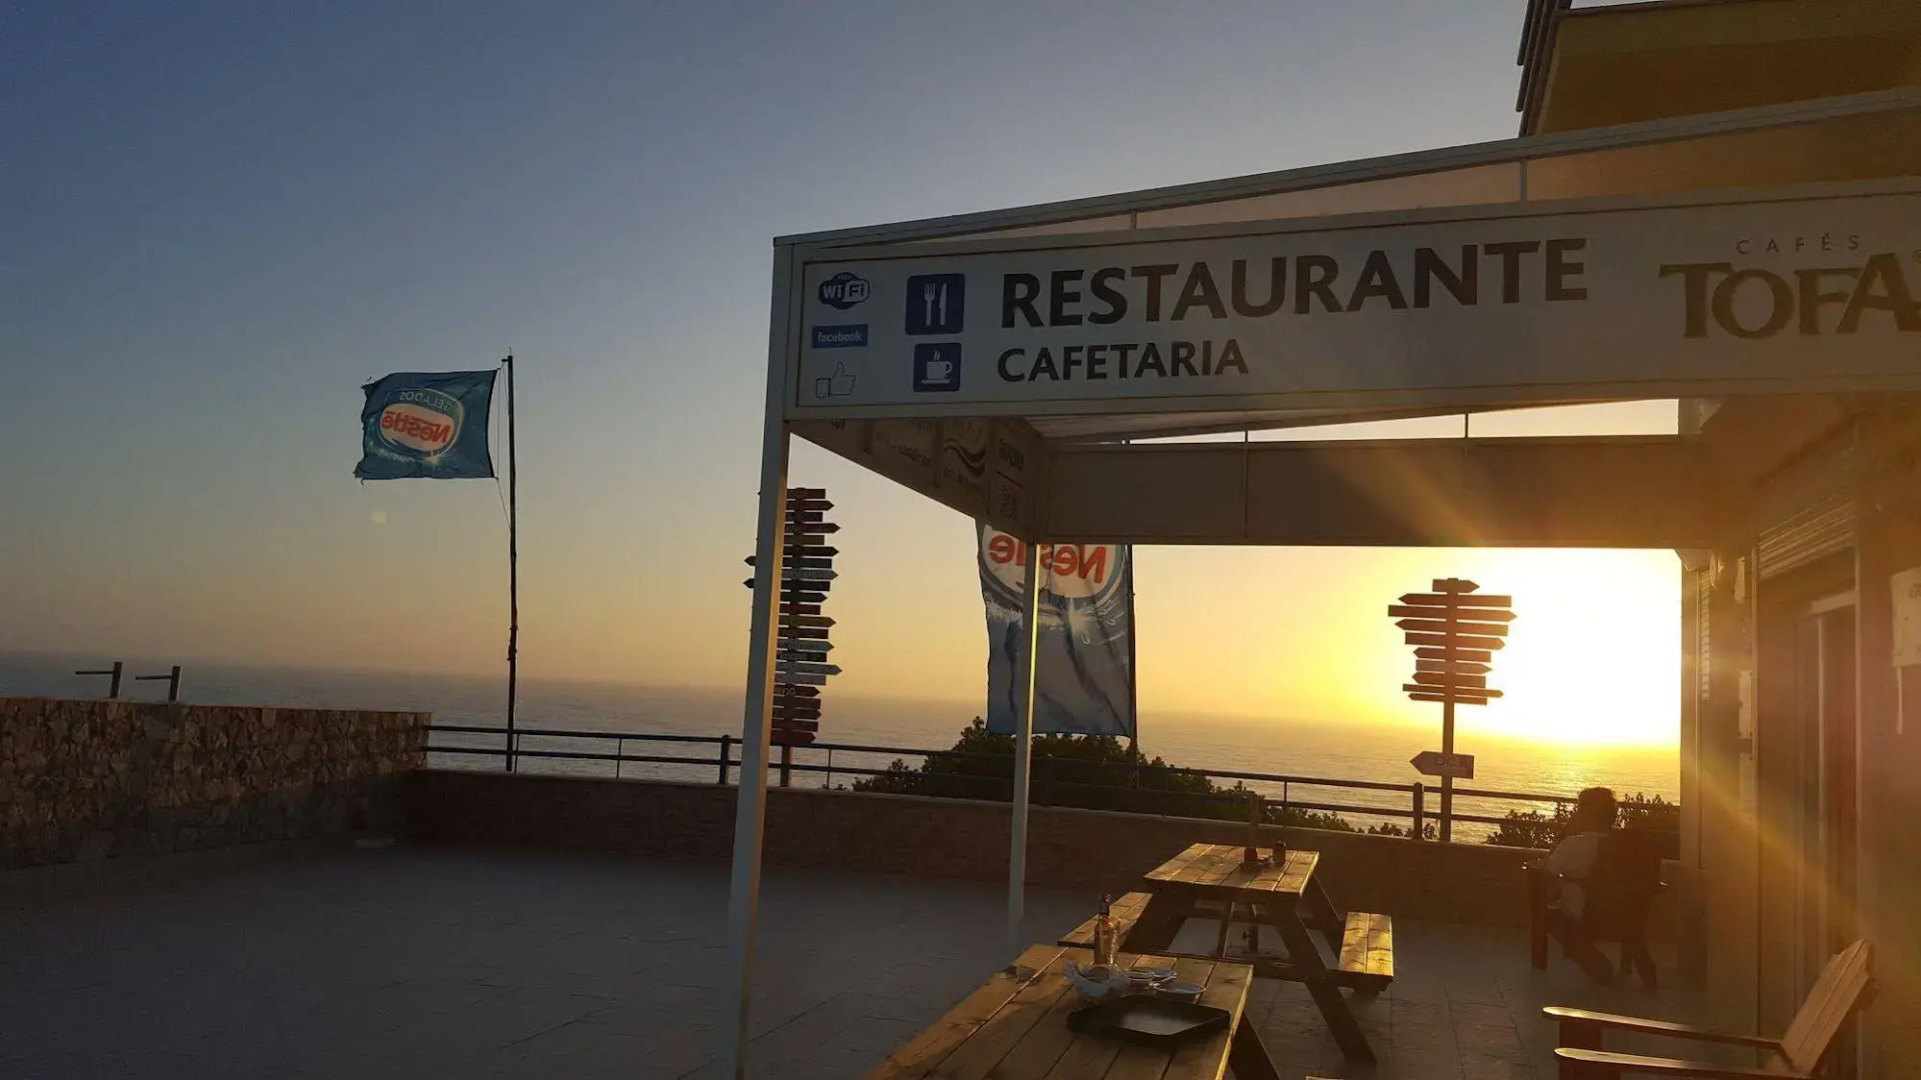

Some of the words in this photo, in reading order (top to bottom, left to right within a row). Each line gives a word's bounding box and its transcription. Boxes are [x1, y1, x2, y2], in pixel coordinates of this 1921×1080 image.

[1736, 231, 1860, 254] CAFÉS
[1002, 238, 1588, 328] RESTAURANTE
[1658, 253, 1921, 339] TOFA
[817, 330, 863, 343] facebook
[997, 338, 1250, 382] CAFETARIA
